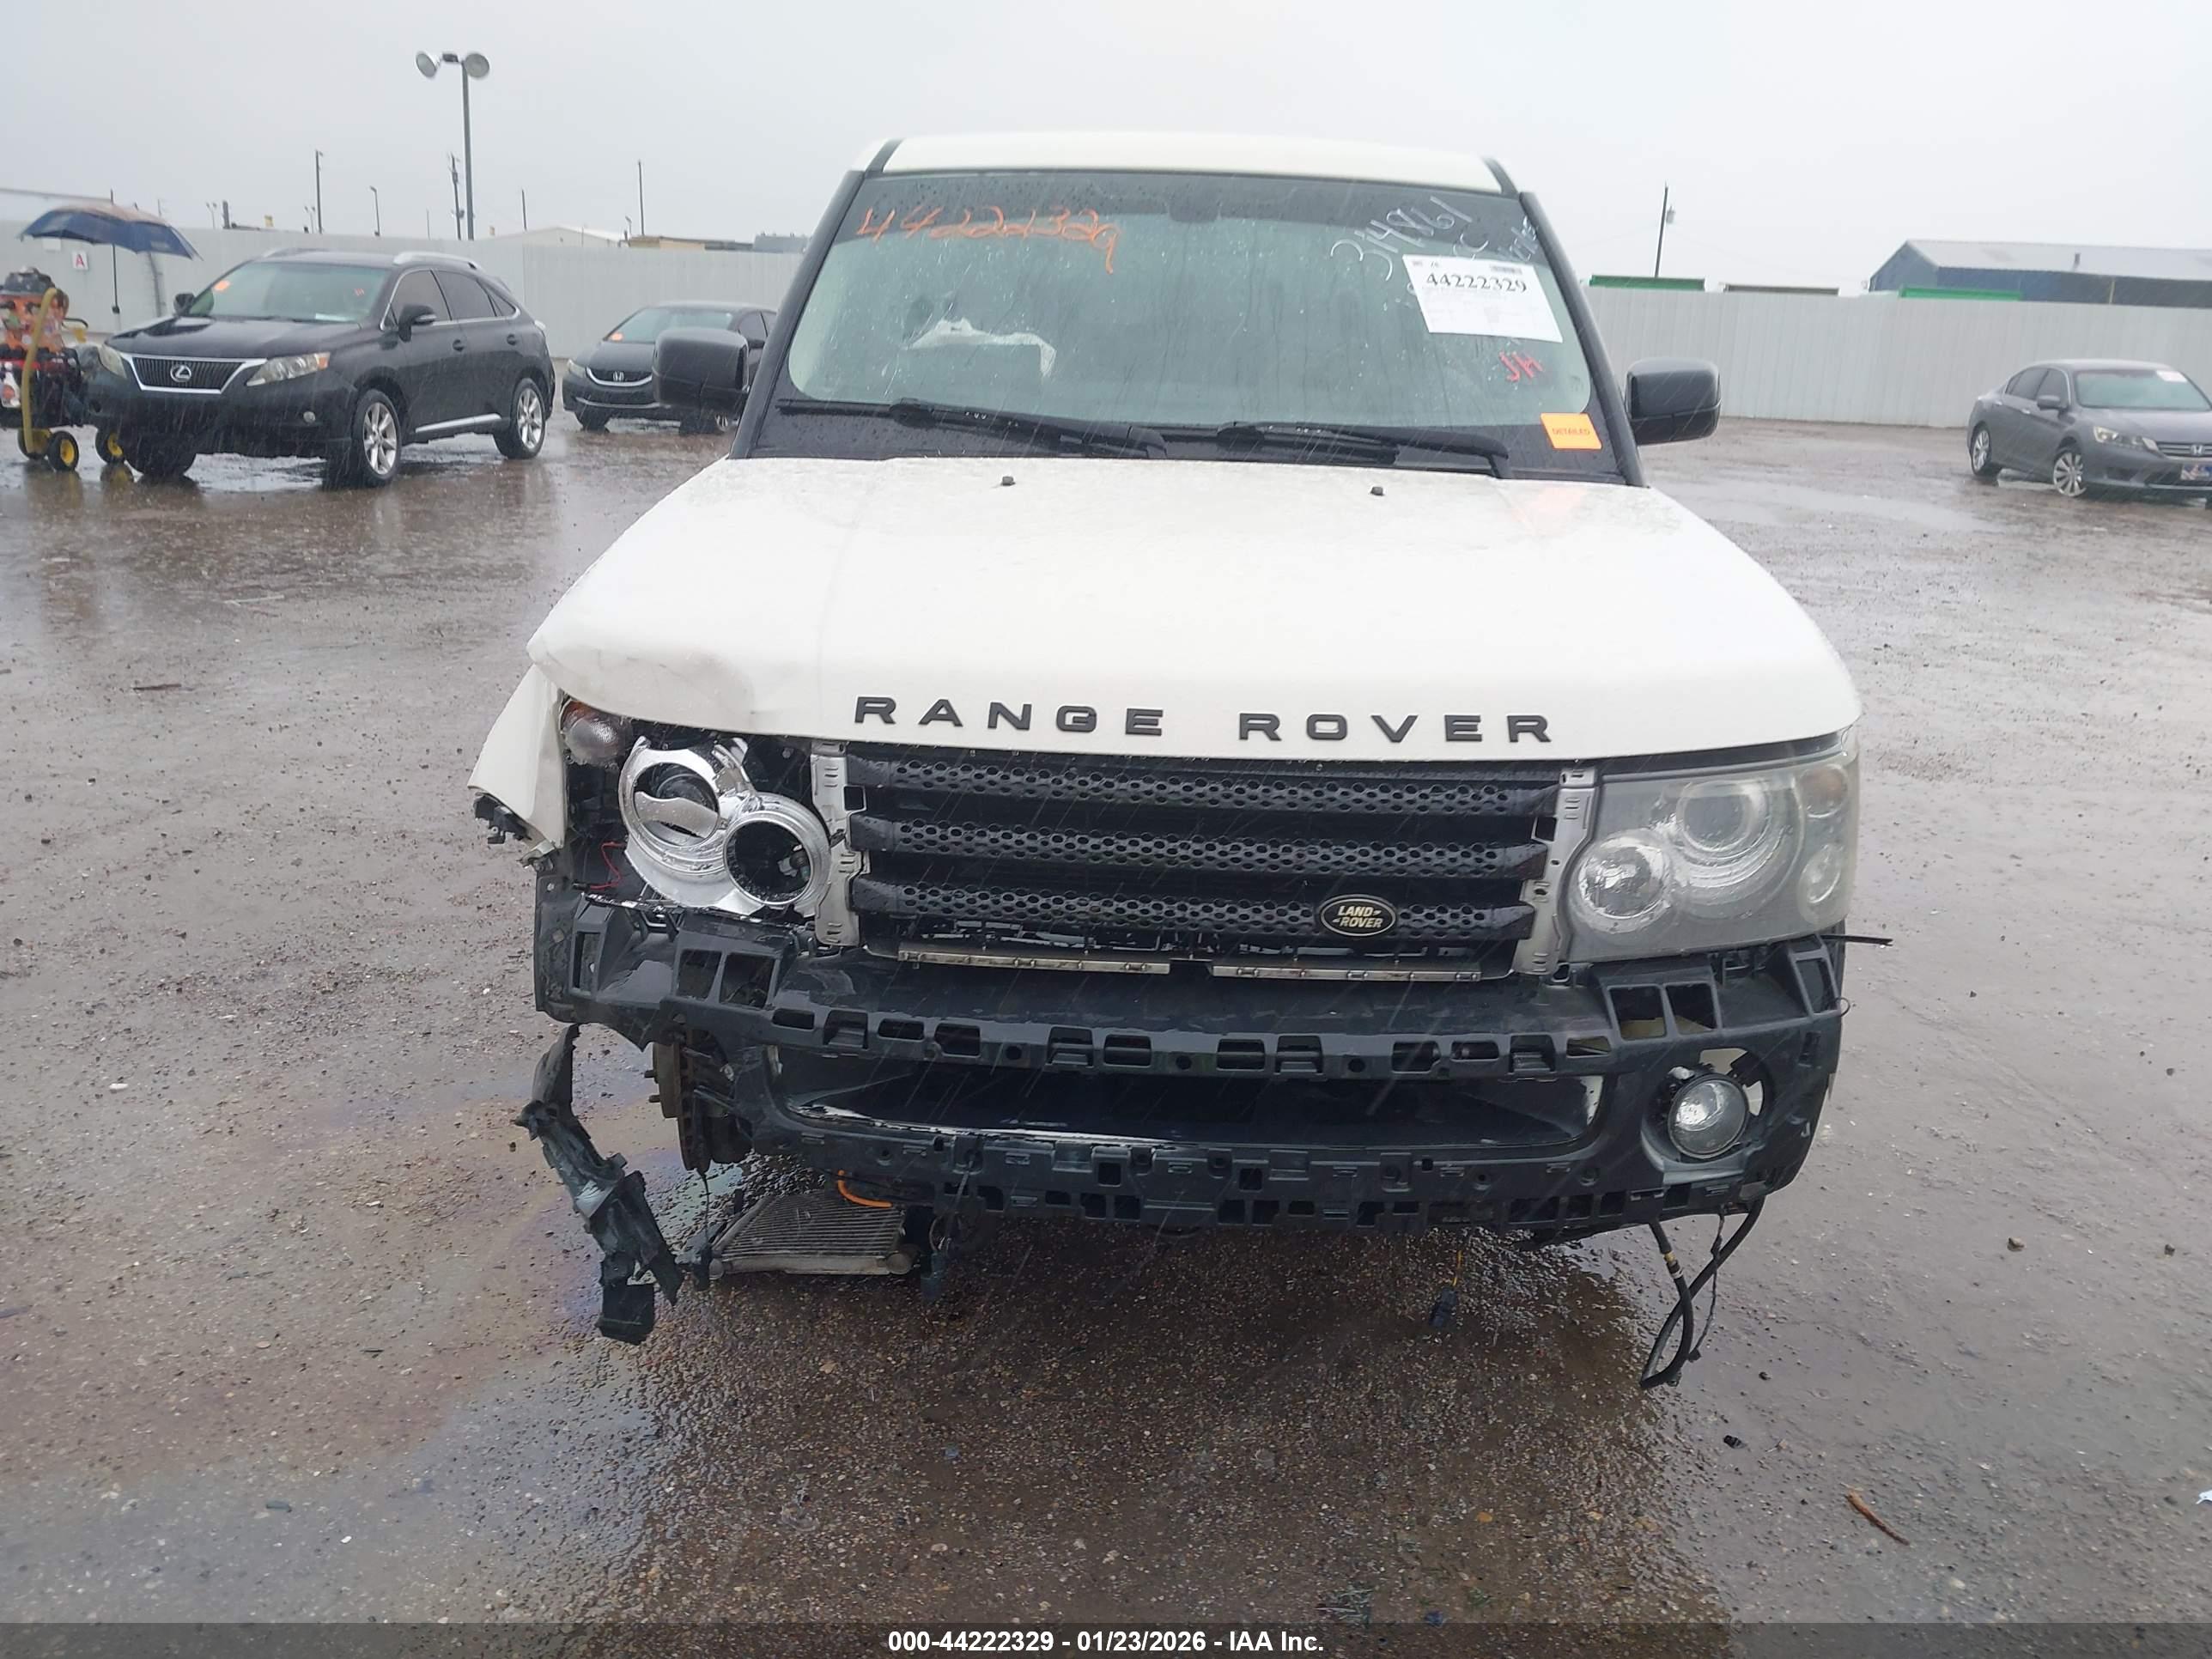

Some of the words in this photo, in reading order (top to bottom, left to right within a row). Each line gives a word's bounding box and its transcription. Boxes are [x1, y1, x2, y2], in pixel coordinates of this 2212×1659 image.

[75, 253, 86, 268] A
[1426, 272, 1527, 293] 44222329
[854, 696, 1164, 736] RANGE
[1238, 713, 1552, 743] ROVER
